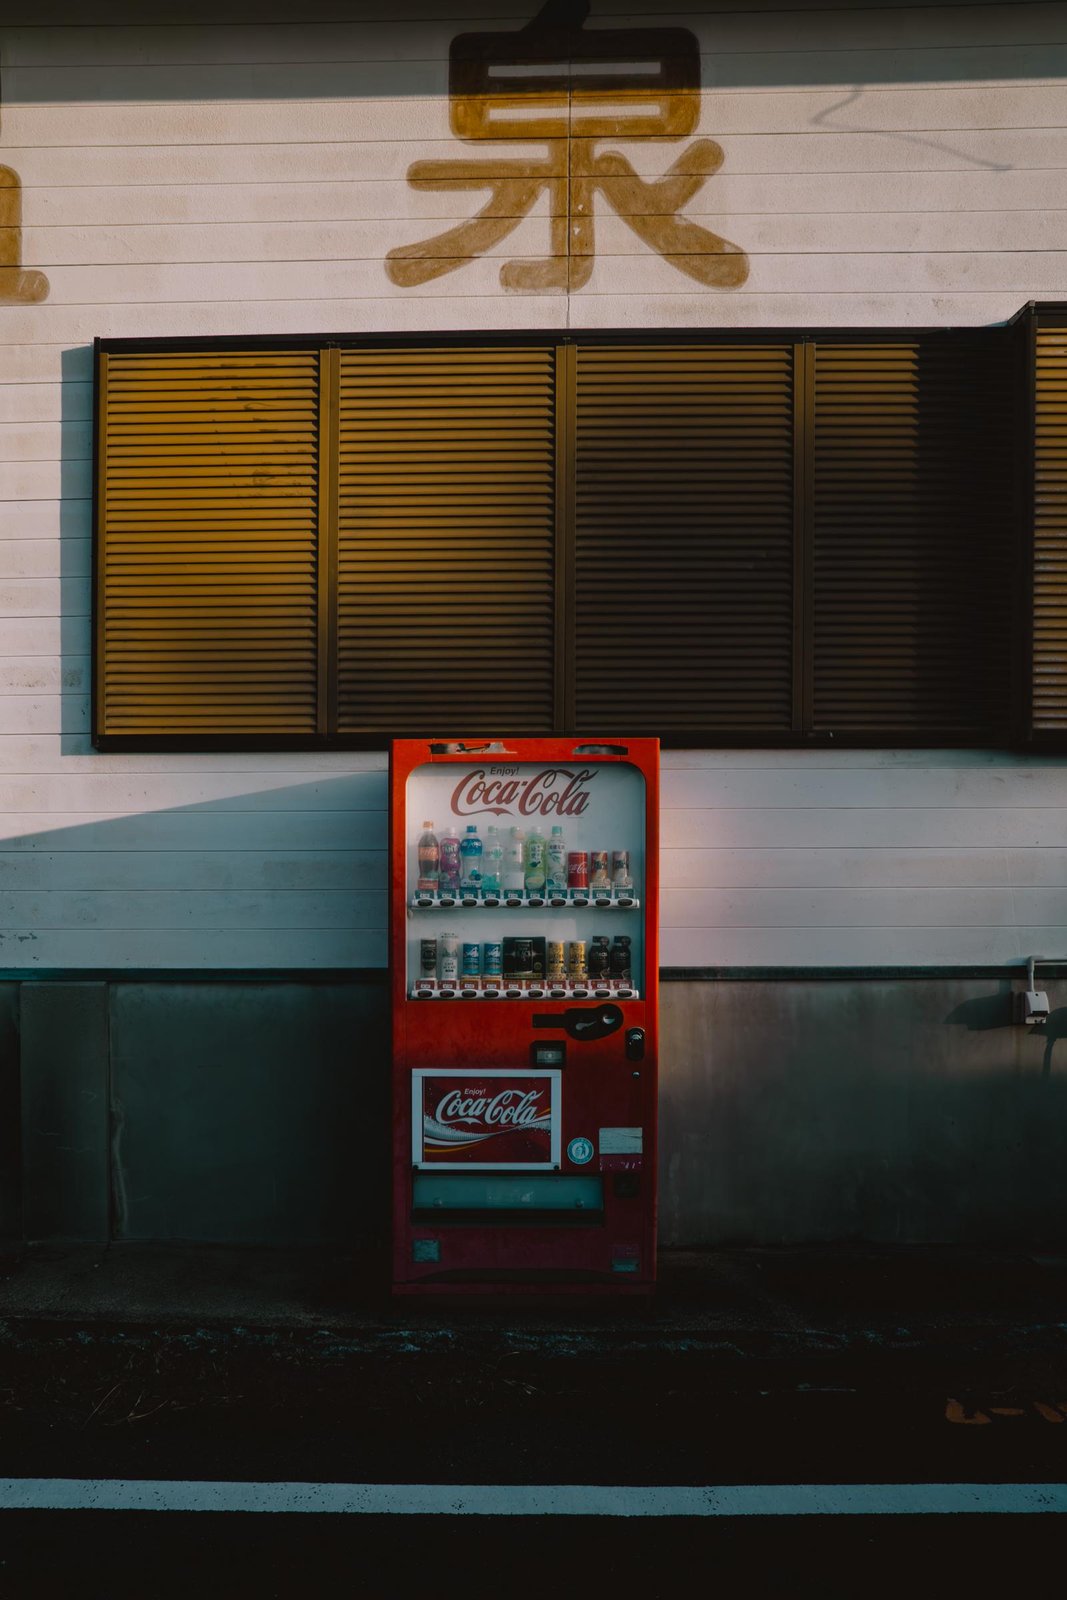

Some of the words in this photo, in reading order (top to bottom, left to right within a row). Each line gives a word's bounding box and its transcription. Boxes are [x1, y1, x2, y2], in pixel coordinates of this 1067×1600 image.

[385, 0, 749, 290] 泉
[489, 766, 520, 776] Enjoy!
[450, 768, 600, 816] Coca-Cola
[435, 1089, 545, 1125] Coca-Cola
[463, 1087, 487, 1096] Enjoy!
